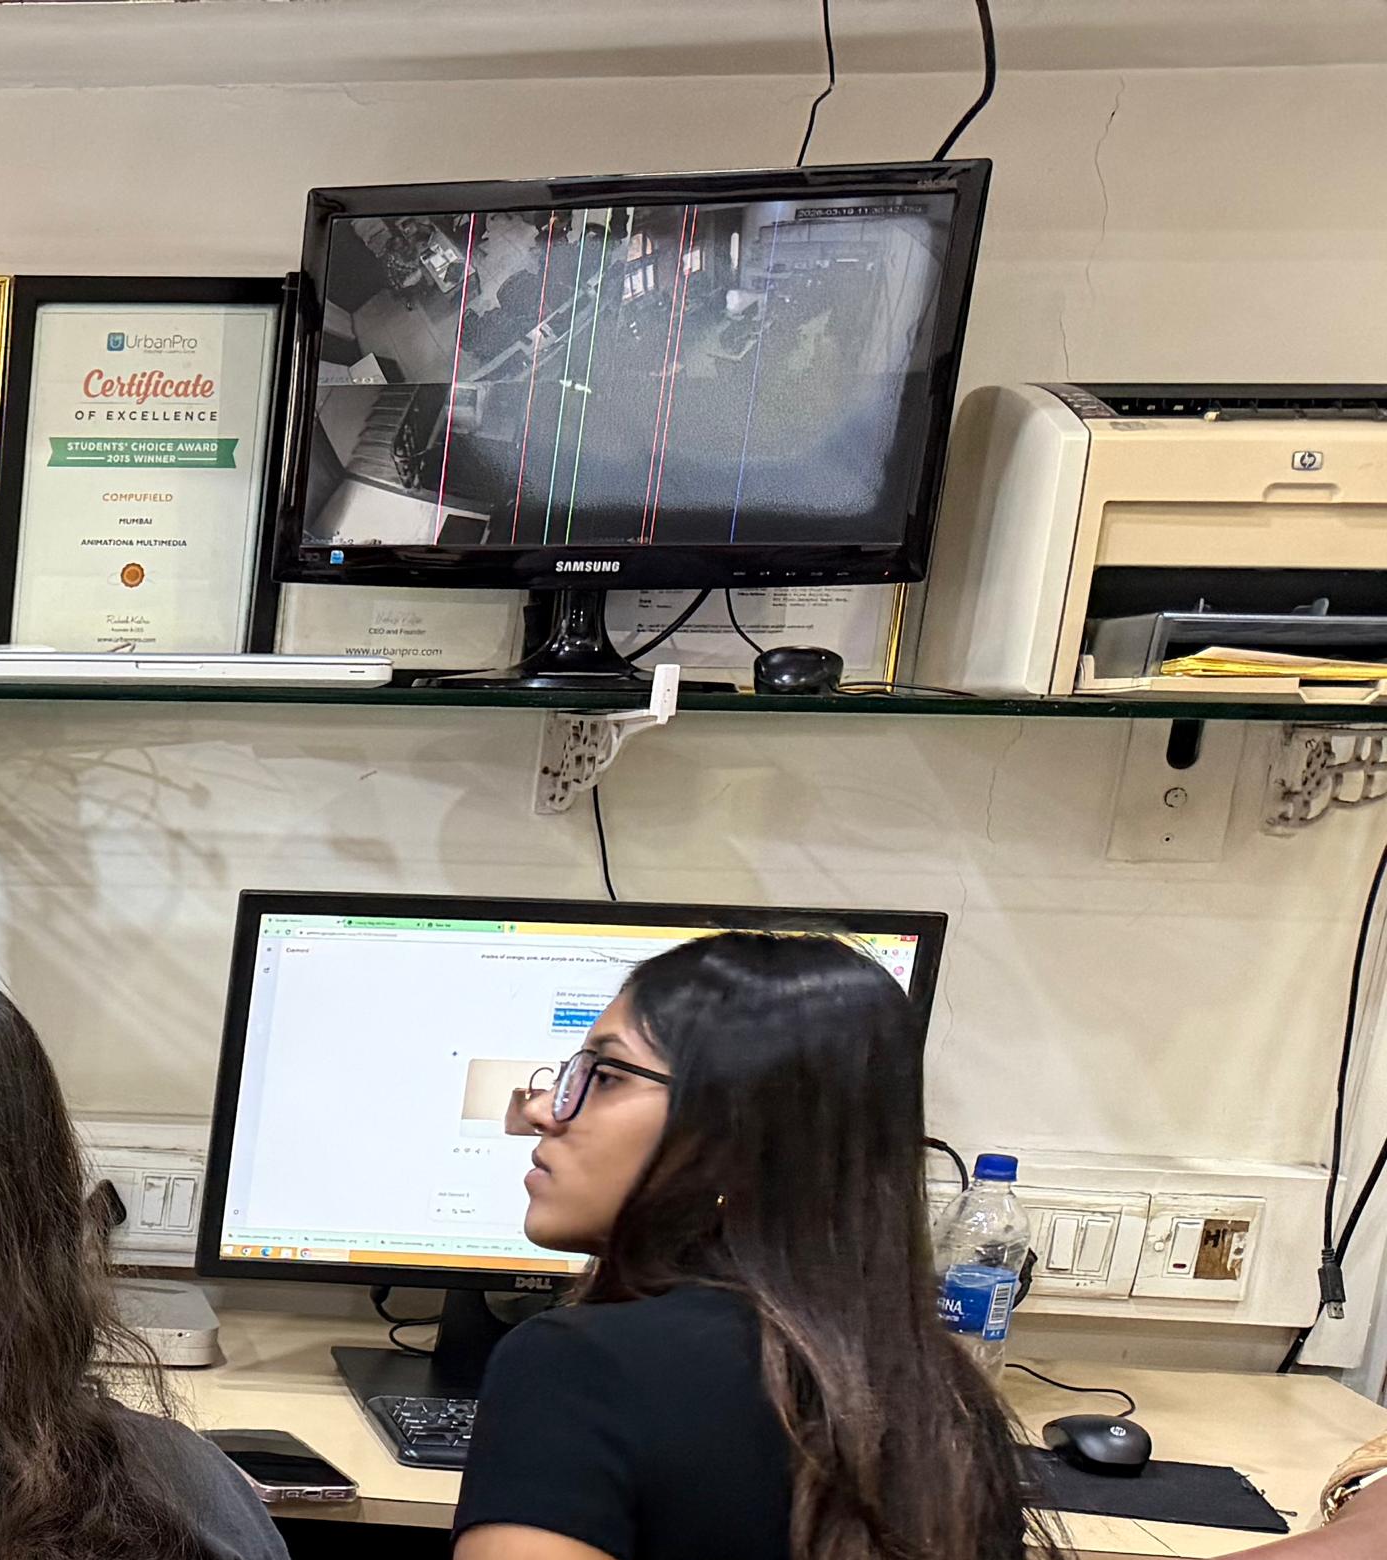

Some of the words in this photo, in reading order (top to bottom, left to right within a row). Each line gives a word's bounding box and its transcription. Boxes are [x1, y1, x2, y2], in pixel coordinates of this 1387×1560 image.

[126, 334, 198, 350] UrbanPro
[83, 369, 215, 405] Certificate
[75, 411, 96, 421] OF
[106, 411, 218, 421] EXCELLENCE
[67, 442, 127, 451] STUDENTS'
[131, 442, 173, 452] CHOICE
[177, 442, 218, 452] AWARD
[106, 454, 130, 463] 2015
[133, 454, 176, 463] WINNER
[102, 493, 173, 502] COMPUFIELD
[136, 539, 187, 547] MULTIMEDIA
[555, 561, 620, 572] SAMSUNG
[345, 647, 442, 657] www.urbanpro.com
[515, 1276, 552, 1290] DELL
